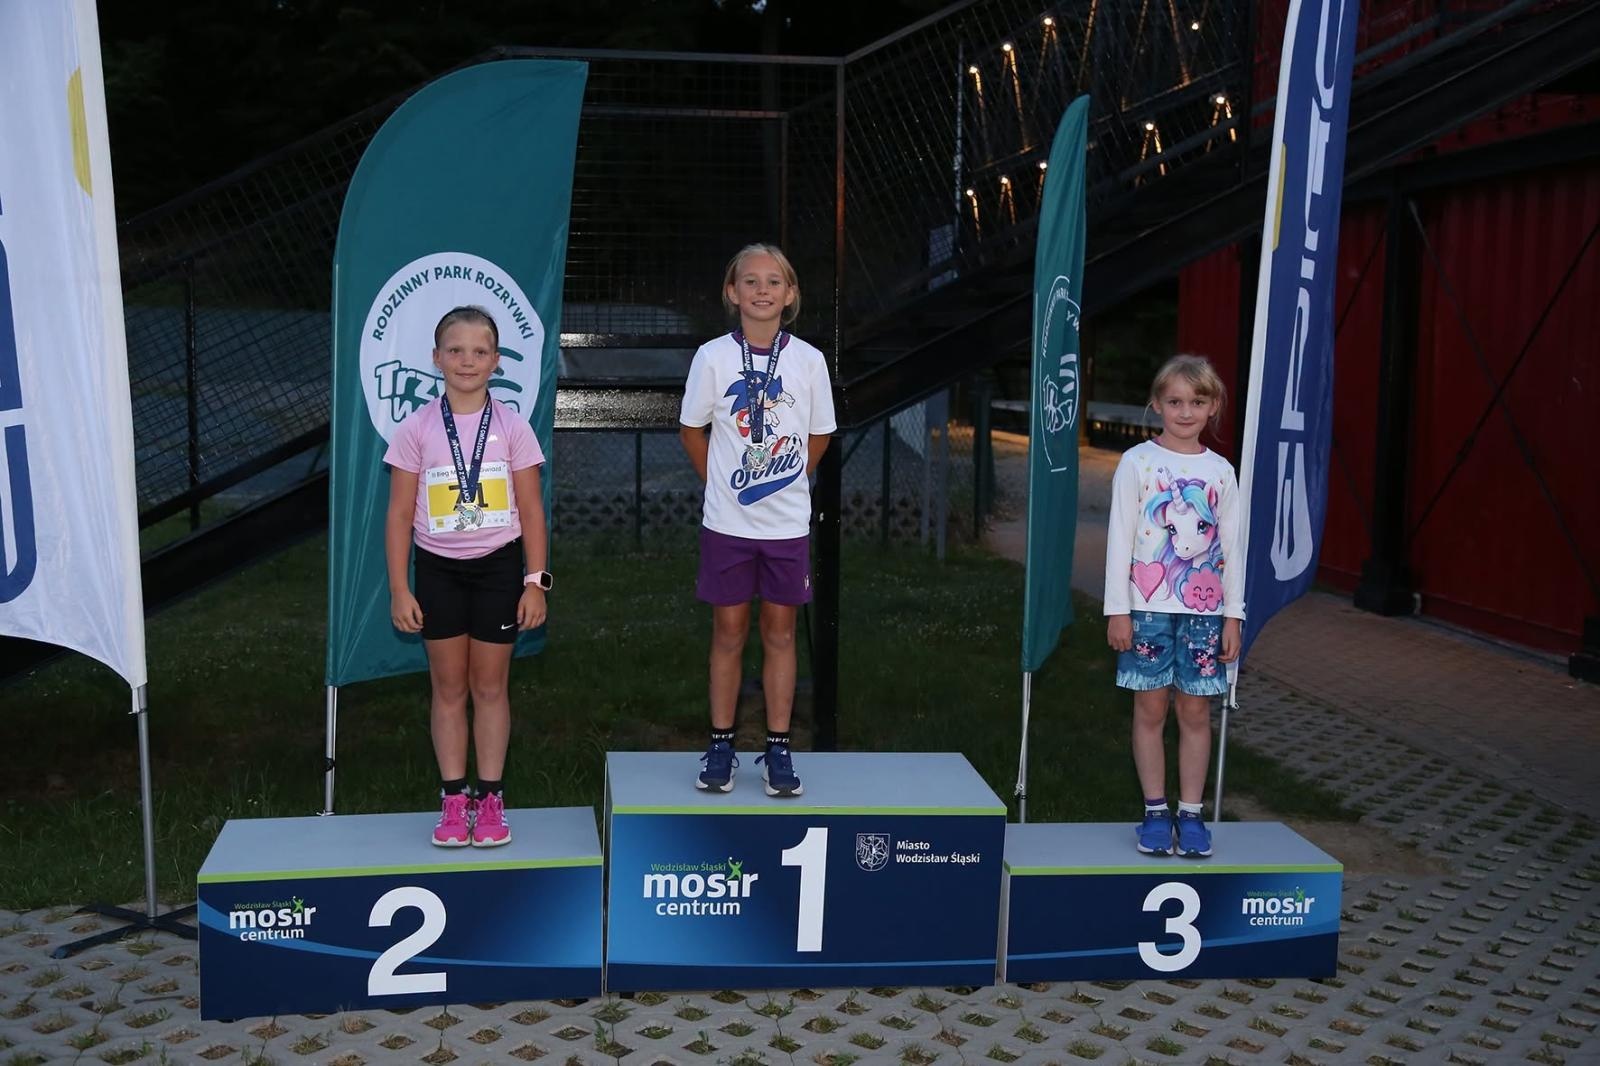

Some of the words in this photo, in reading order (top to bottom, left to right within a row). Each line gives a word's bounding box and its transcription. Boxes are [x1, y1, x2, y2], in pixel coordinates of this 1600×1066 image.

[372, 268, 431, 341] RODZINNY
[434, 265, 473, 280] PARK
[475, 271, 535, 340] ROZRYWKI
[896, 840, 930, 850] Miasto
[650, 863, 699, 872] Wodzisław
[701, 861, 726, 873] Śląski
[896, 853, 949, 863] Wodzisław
[950, 852, 981, 866] Śląski
[643, 873, 759, 898] mosir
[781, 827, 828, 952] 1
[233, 901, 271, 910] Wodzisław
[272, 899, 292, 909] Śląski
[656, 899, 740, 916] centrum
[1242, 897, 1316, 914] mosir
[229, 906, 317, 930] mosir
[1138, 880, 1202, 973] 3
[1249, 915, 1304, 926] centrum
[239, 928, 305, 942] centrum
[367, 886, 448, 997] 2
